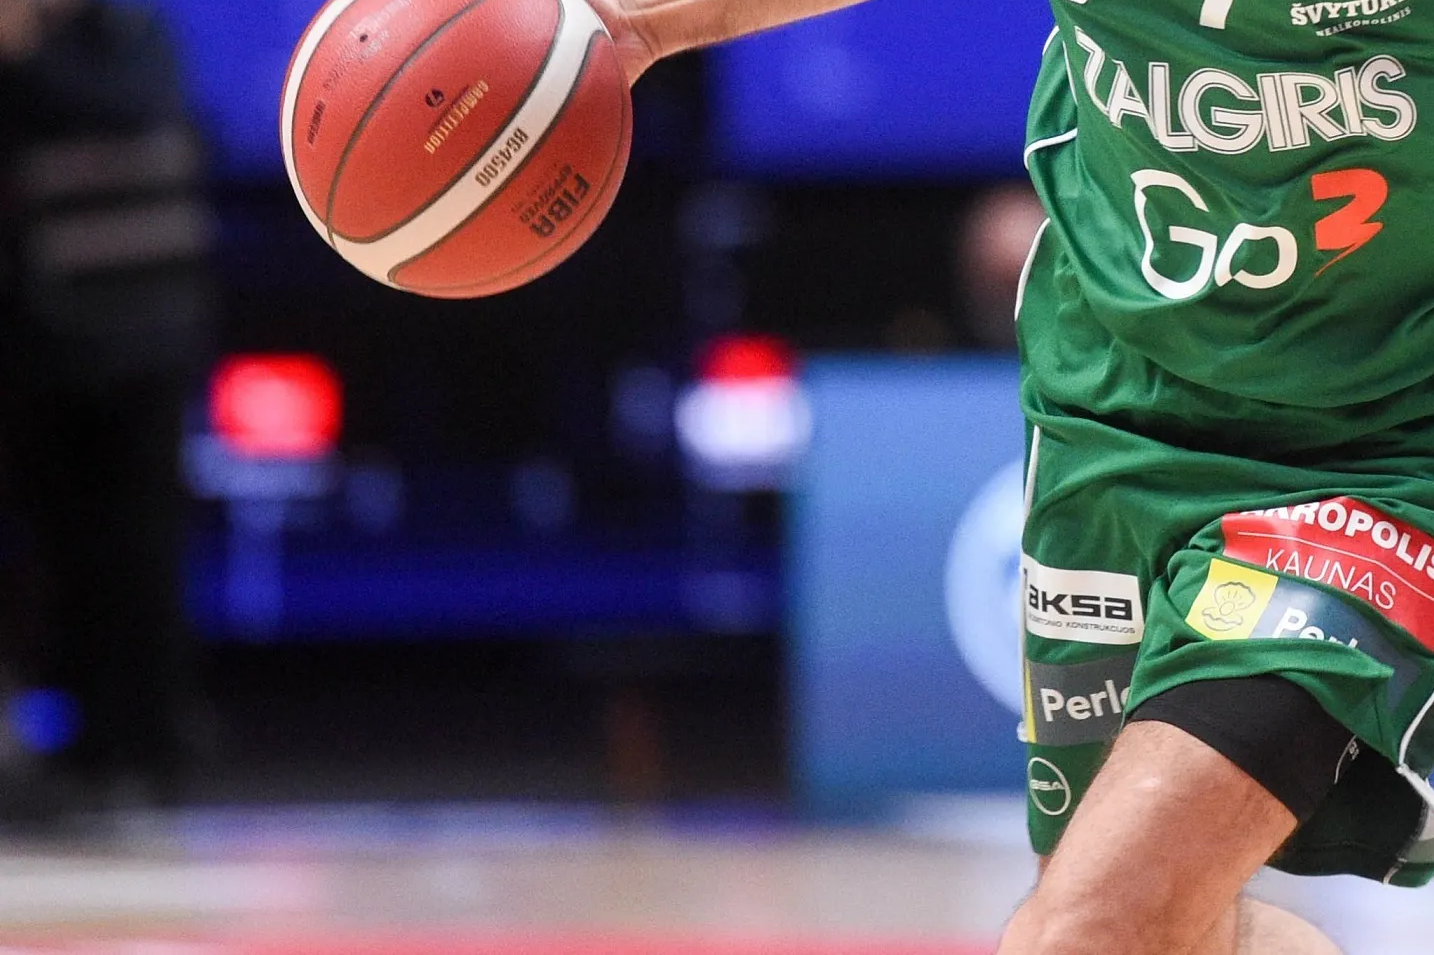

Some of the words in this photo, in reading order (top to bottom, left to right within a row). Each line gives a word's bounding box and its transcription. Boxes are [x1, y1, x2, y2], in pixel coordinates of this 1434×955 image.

[474, 127, 529, 187] BG4500
[530, 171, 591, 238] FIBA
[1265, 548, 1397, 610] KAUNAS
